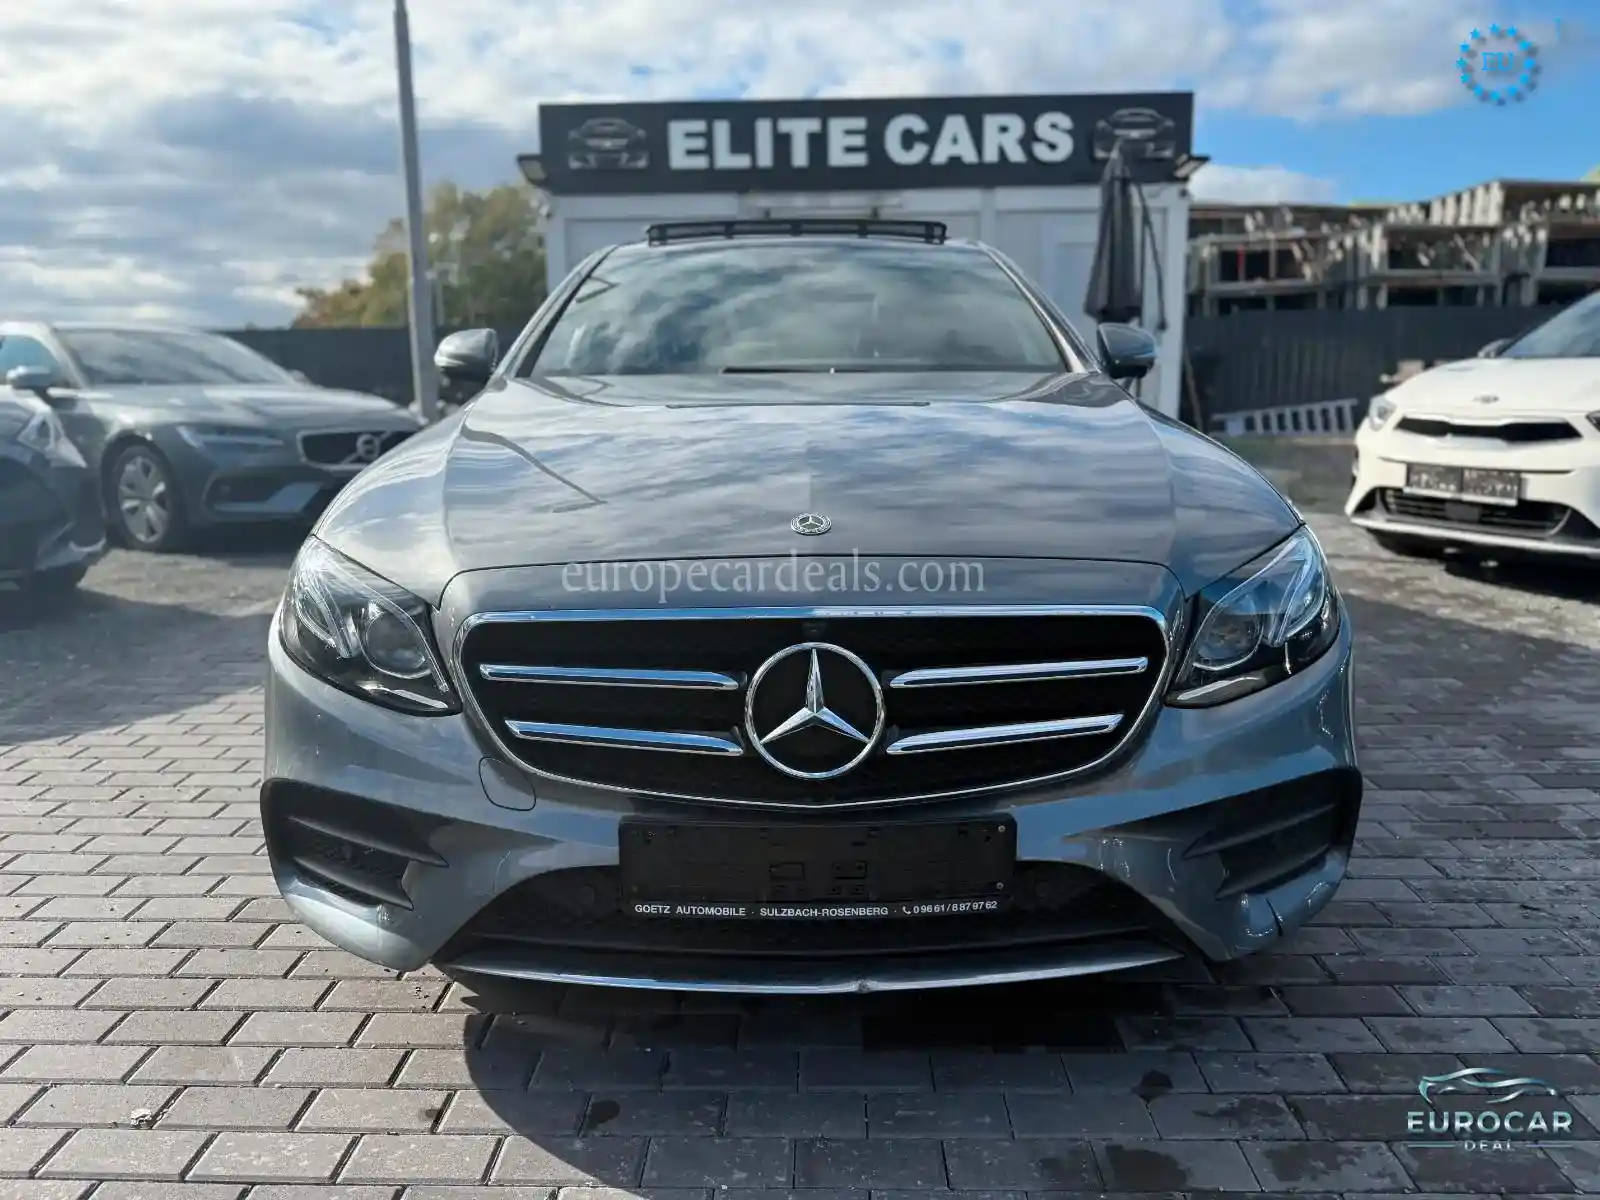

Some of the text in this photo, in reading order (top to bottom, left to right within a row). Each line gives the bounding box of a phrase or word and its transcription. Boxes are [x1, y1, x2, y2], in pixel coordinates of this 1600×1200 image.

[667, 111, 1075, 171] ELITE CARS
[634, 904, 671, 915] GOETZ
[675, 905, 747, 917] AUTOMOBILE
[759, 902, 889, 917] SULZBACH-ROSENBERG
